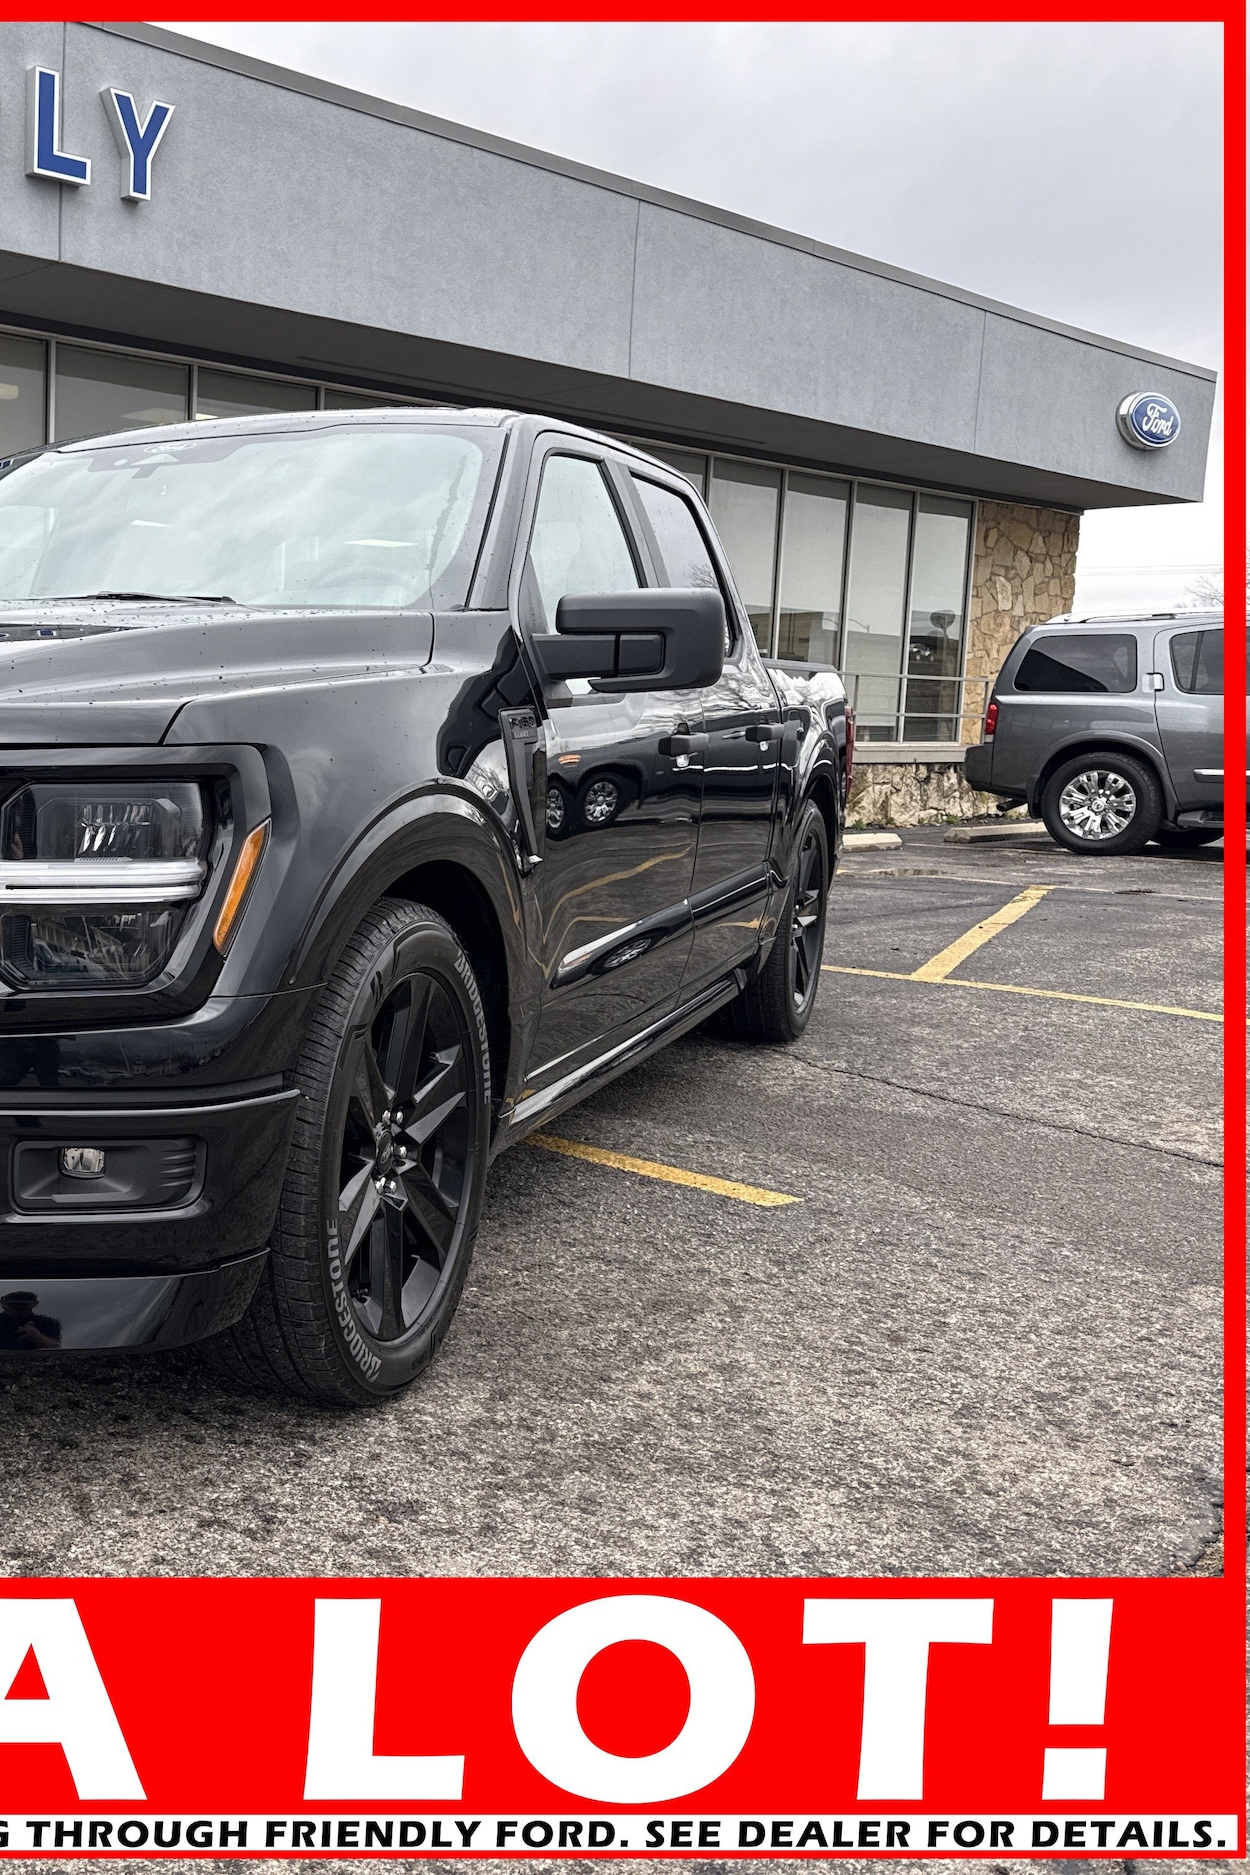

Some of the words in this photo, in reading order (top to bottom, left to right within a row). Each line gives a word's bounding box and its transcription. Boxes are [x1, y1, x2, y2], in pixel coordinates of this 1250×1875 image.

[1142, 403, 1174, 436] Ford
[453, 950, 492, 1104] BRIDGESTONE
[326, 1218, 383, 1383] BRIDGESTONE
